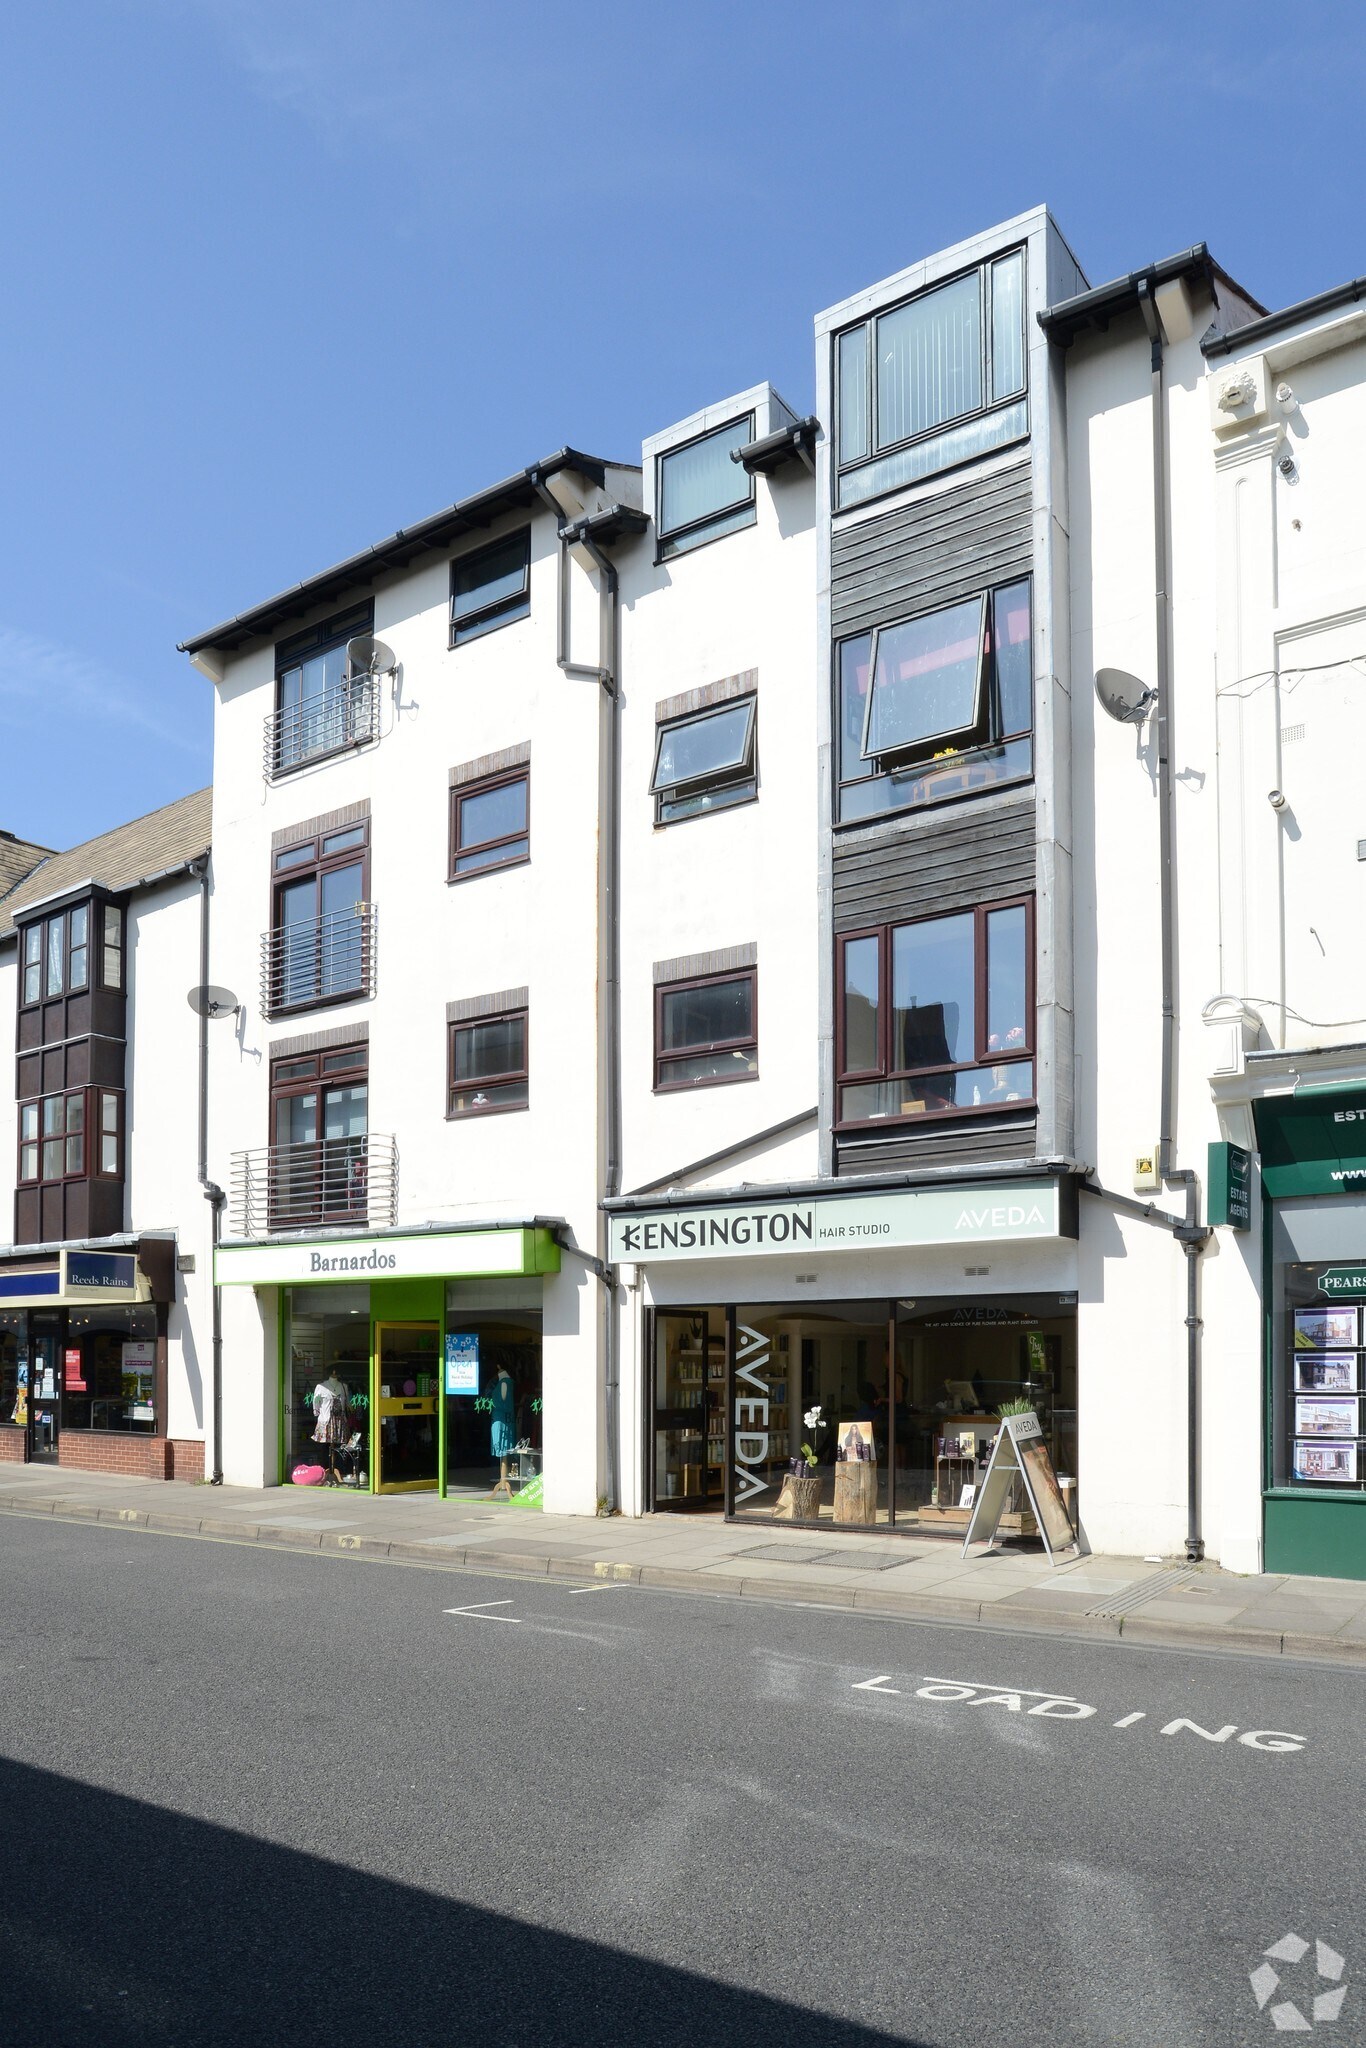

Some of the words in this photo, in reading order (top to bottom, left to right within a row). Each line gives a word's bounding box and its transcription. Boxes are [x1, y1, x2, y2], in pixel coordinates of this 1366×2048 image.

[1230, 1186, 1248, 1202] ESTATE
[955, 1205, 1046, 1230] AVEDA
[1229, 1203, 1248, 1219] AGENTS
[620, 1211, 812, 1251] KENSINGTON
[819, 1227, 846, 1238] HAIR
[848, 1223, 890, 1236] STUDIO
[310, 1249, 397, 1273] Barnardos
[72, 1275, 99, 1285] Reeds
[102, 1276, 129, 1287] Rains
[954, 1308, 1008, 1320] AVEDA
[734, 1325, 771, 1504] AVEDA
[1015, 1421, 1038, 1435] AVEDA
[851, 1676, 1307, 1752] LOADING
